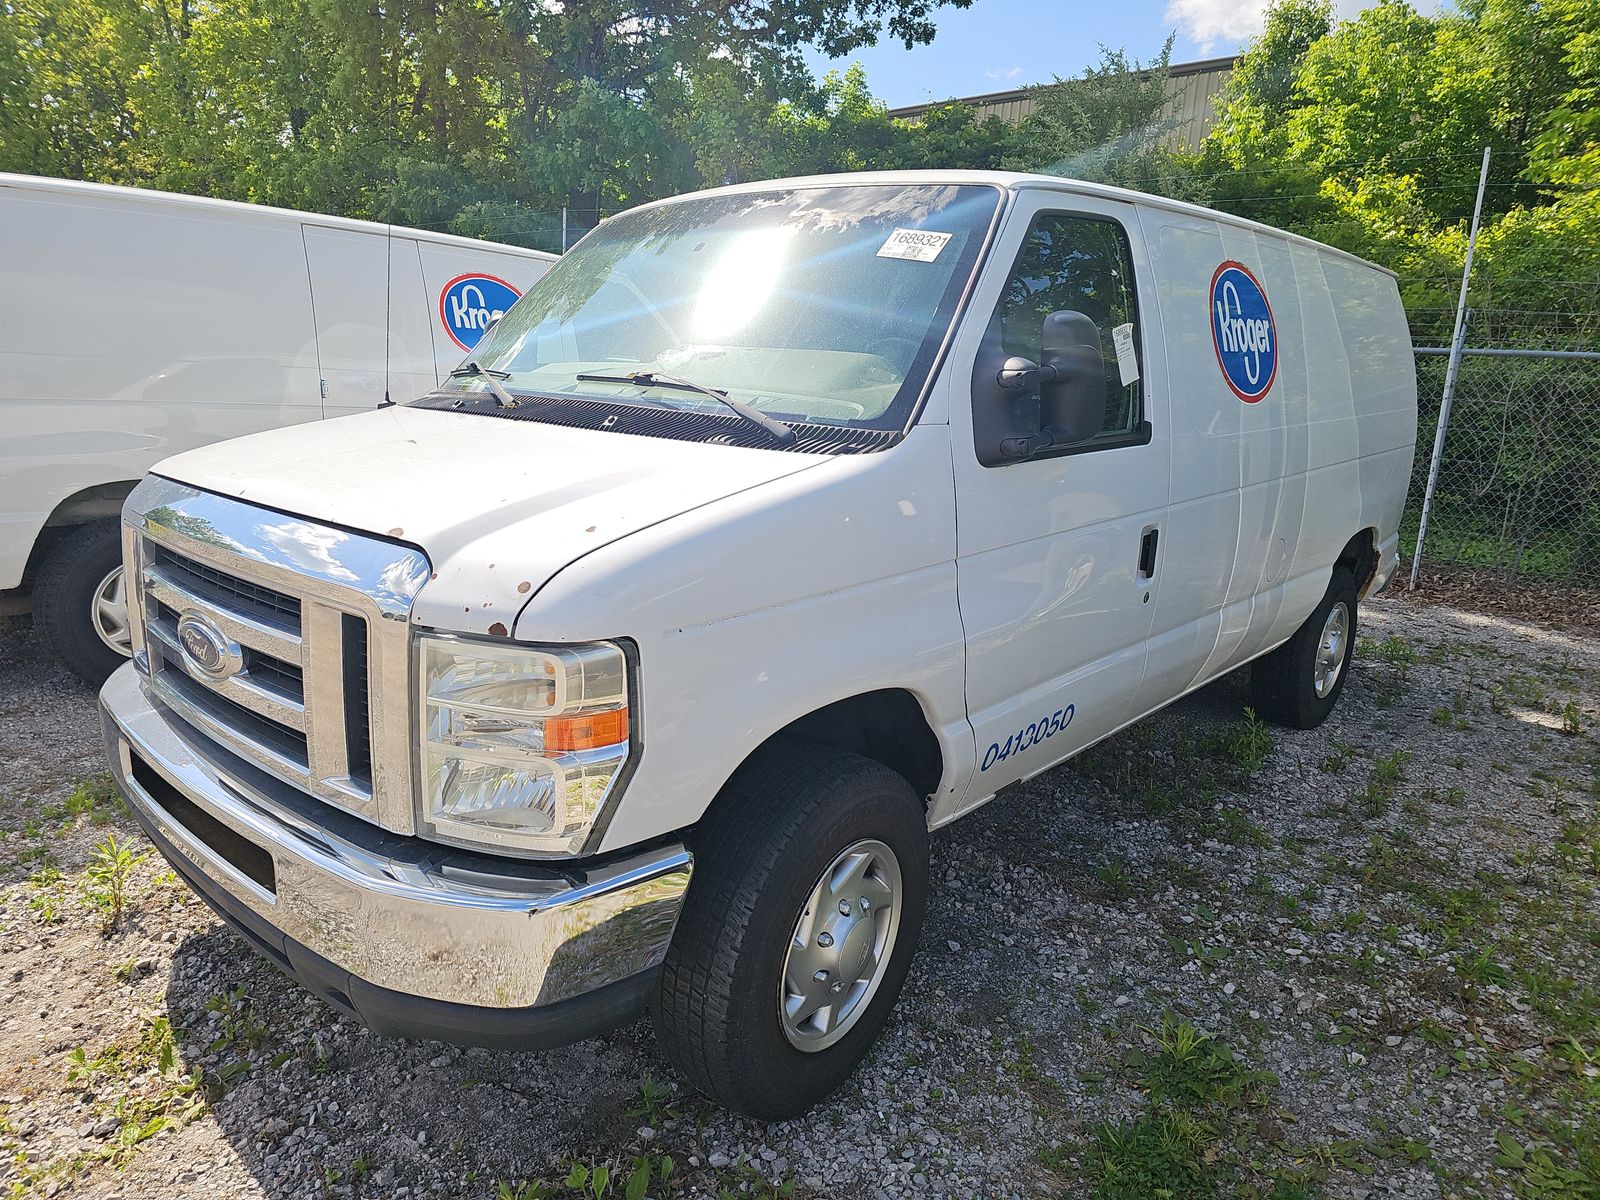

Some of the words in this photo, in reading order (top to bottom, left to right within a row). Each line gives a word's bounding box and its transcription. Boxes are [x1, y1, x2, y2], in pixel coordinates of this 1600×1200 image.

[893, 231, 949, 248] 1689321
[1216, 280, 1271, 385] Kroger
[185, 628, 208, 661] Ford
[981, 703, 1075, 772] 0413050
